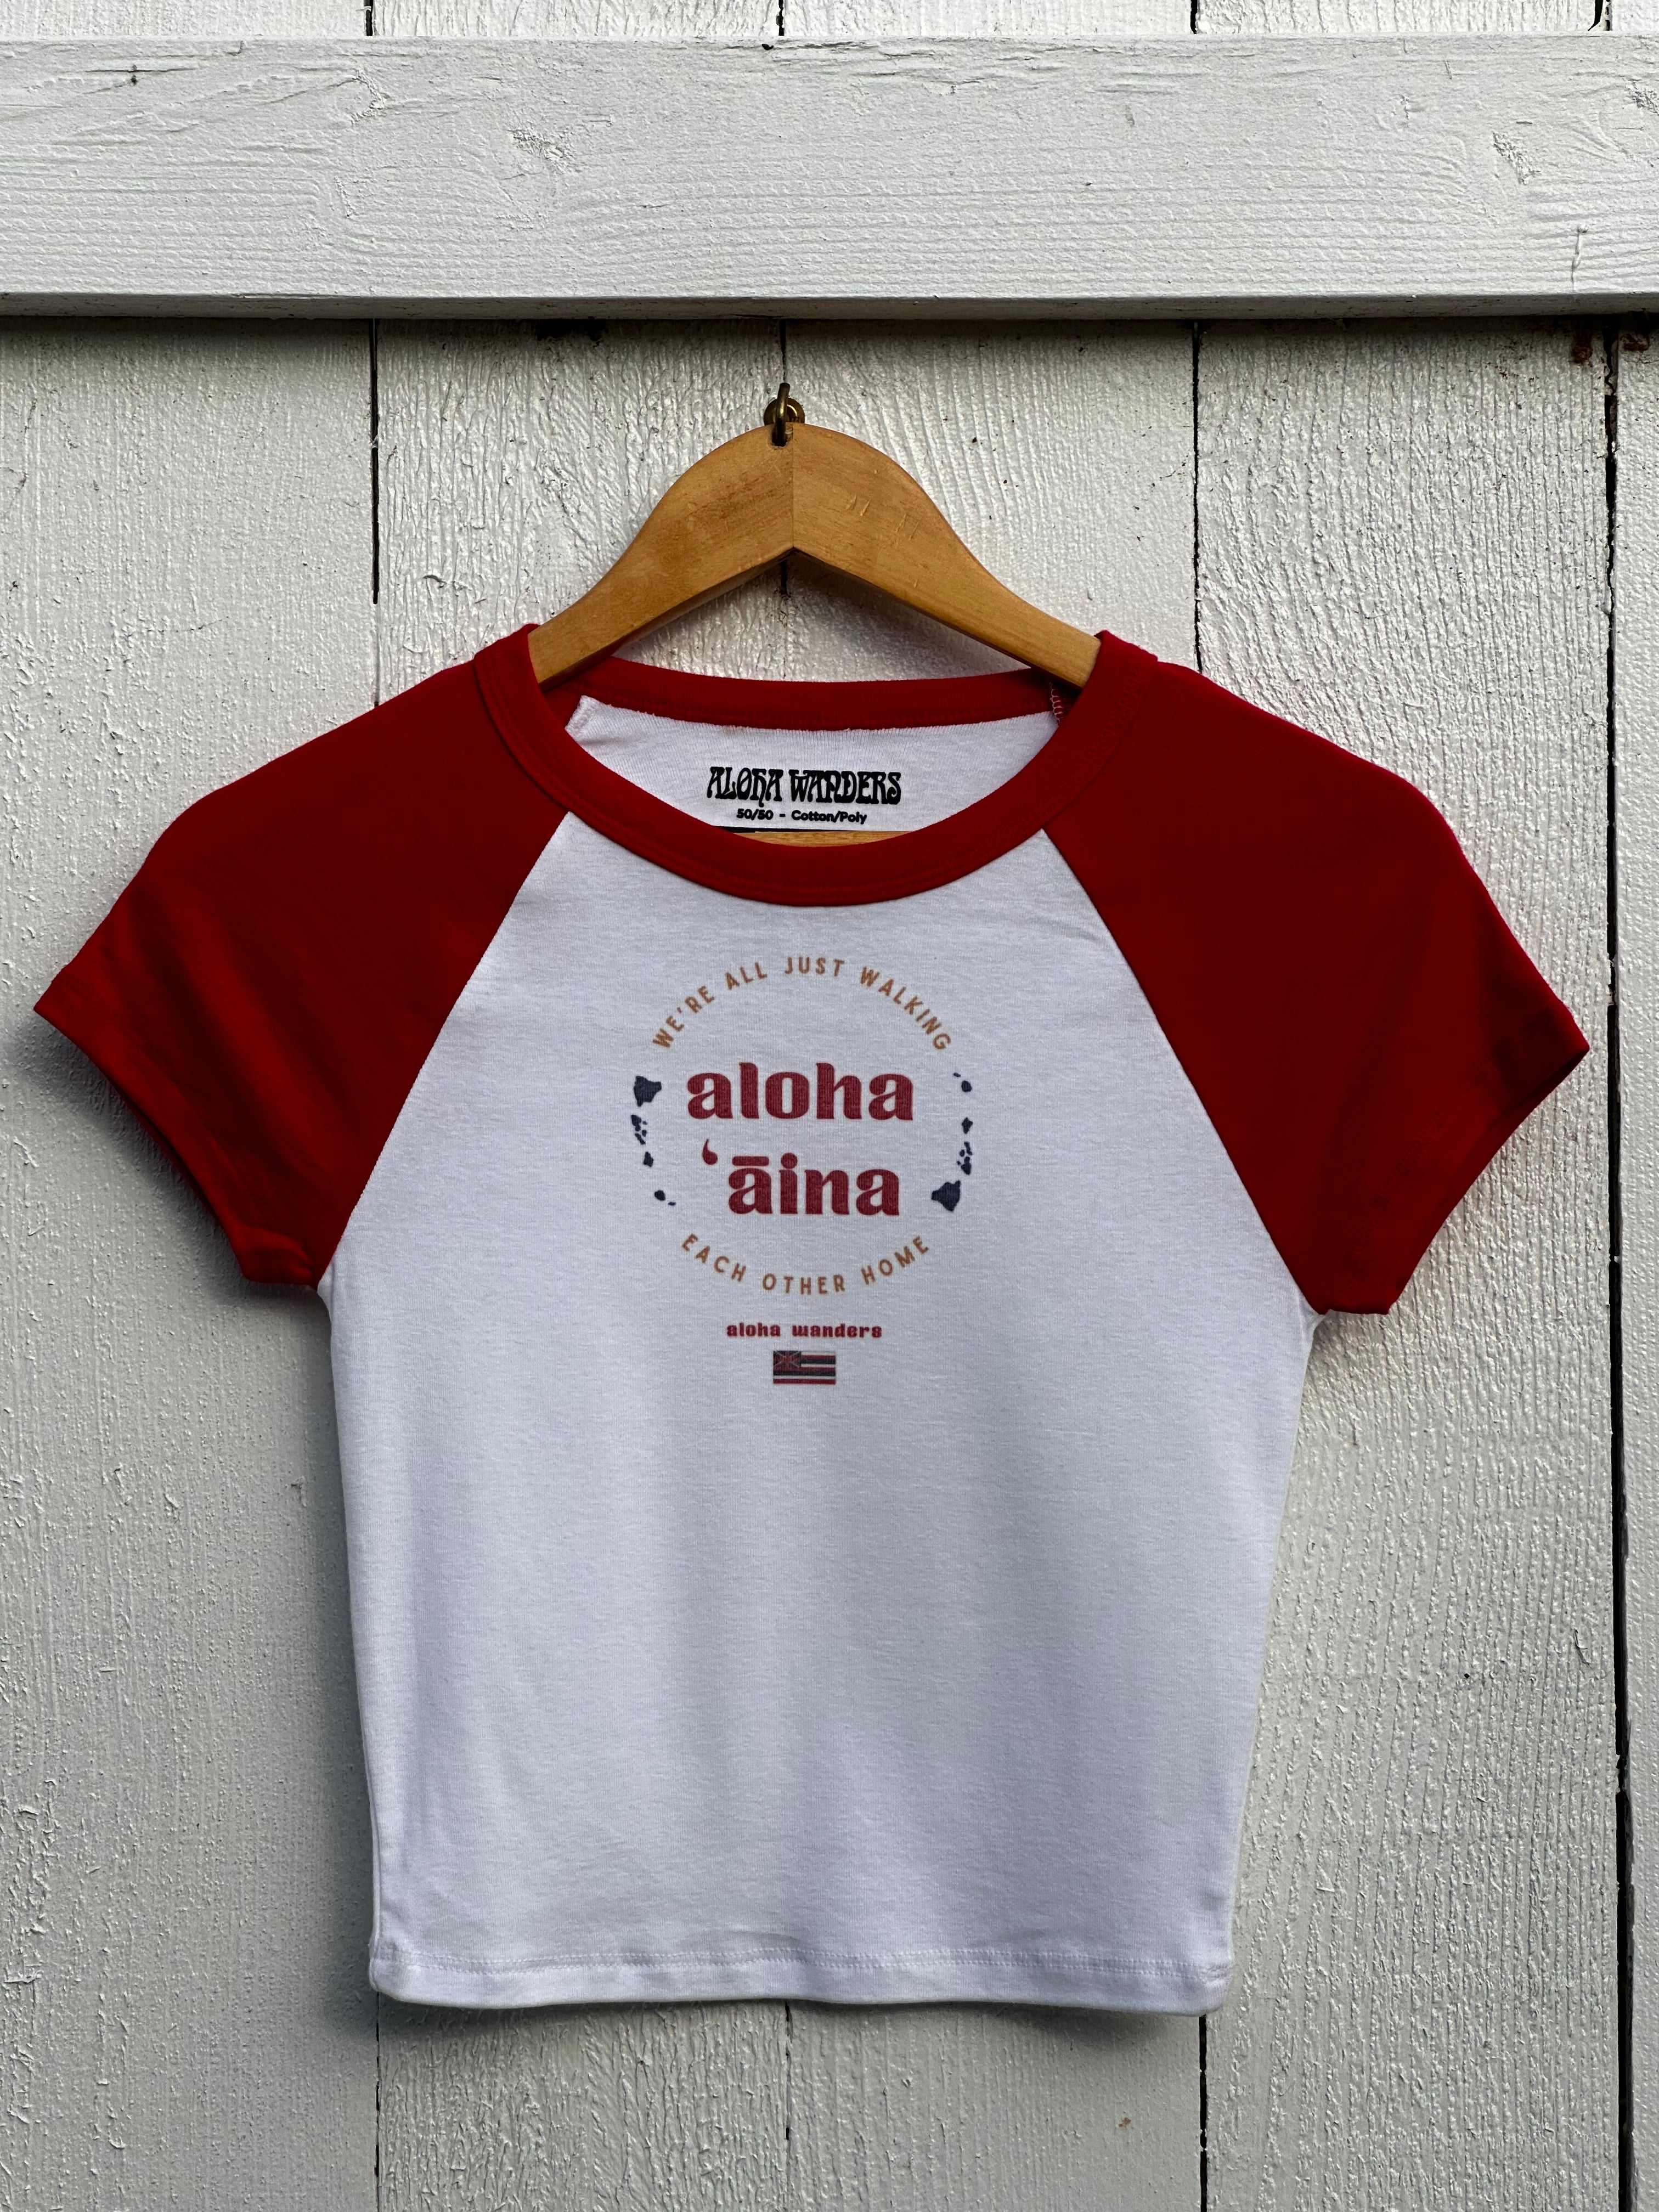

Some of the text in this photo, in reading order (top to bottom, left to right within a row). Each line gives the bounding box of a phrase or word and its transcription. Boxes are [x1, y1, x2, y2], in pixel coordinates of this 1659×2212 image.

[707, 766, 901, 808] ALOHA WANDERS
[736, 809, 774, 820] 50/50
[791, 810, 867, 825] Cotton/Poly
[652, 956, 951, 1050] WE'RE ALL JUST WALKING
[687, 1062, 913, 1121] aloha
[681, 1234, 929, 1295] EACH OTHER HOME
[727, 1323, 882, 1338] aloha wanders
